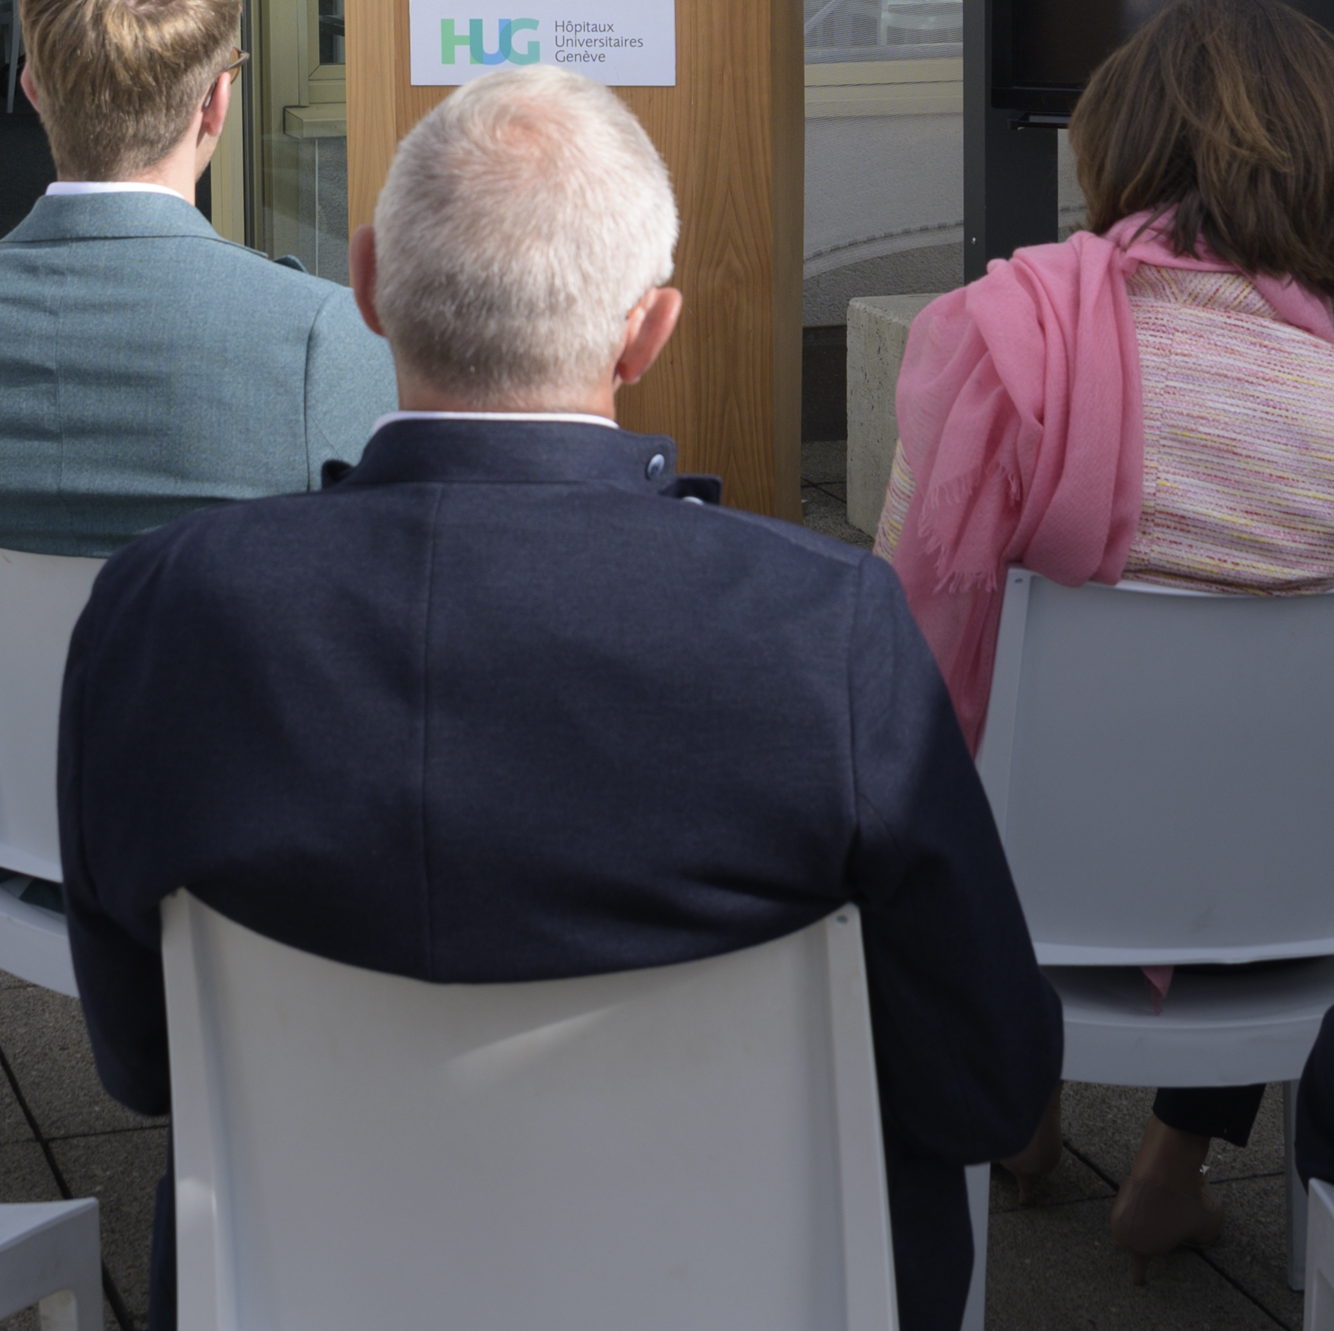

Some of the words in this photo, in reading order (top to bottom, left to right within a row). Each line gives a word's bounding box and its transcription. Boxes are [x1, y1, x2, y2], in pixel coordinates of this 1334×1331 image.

[555, 20, 615, 38] Hôpitaux
[441, 17, 540, 65] HUG
[555, 35, 644, 48] Universitaires
[555, 50, 606, 63] Genève
